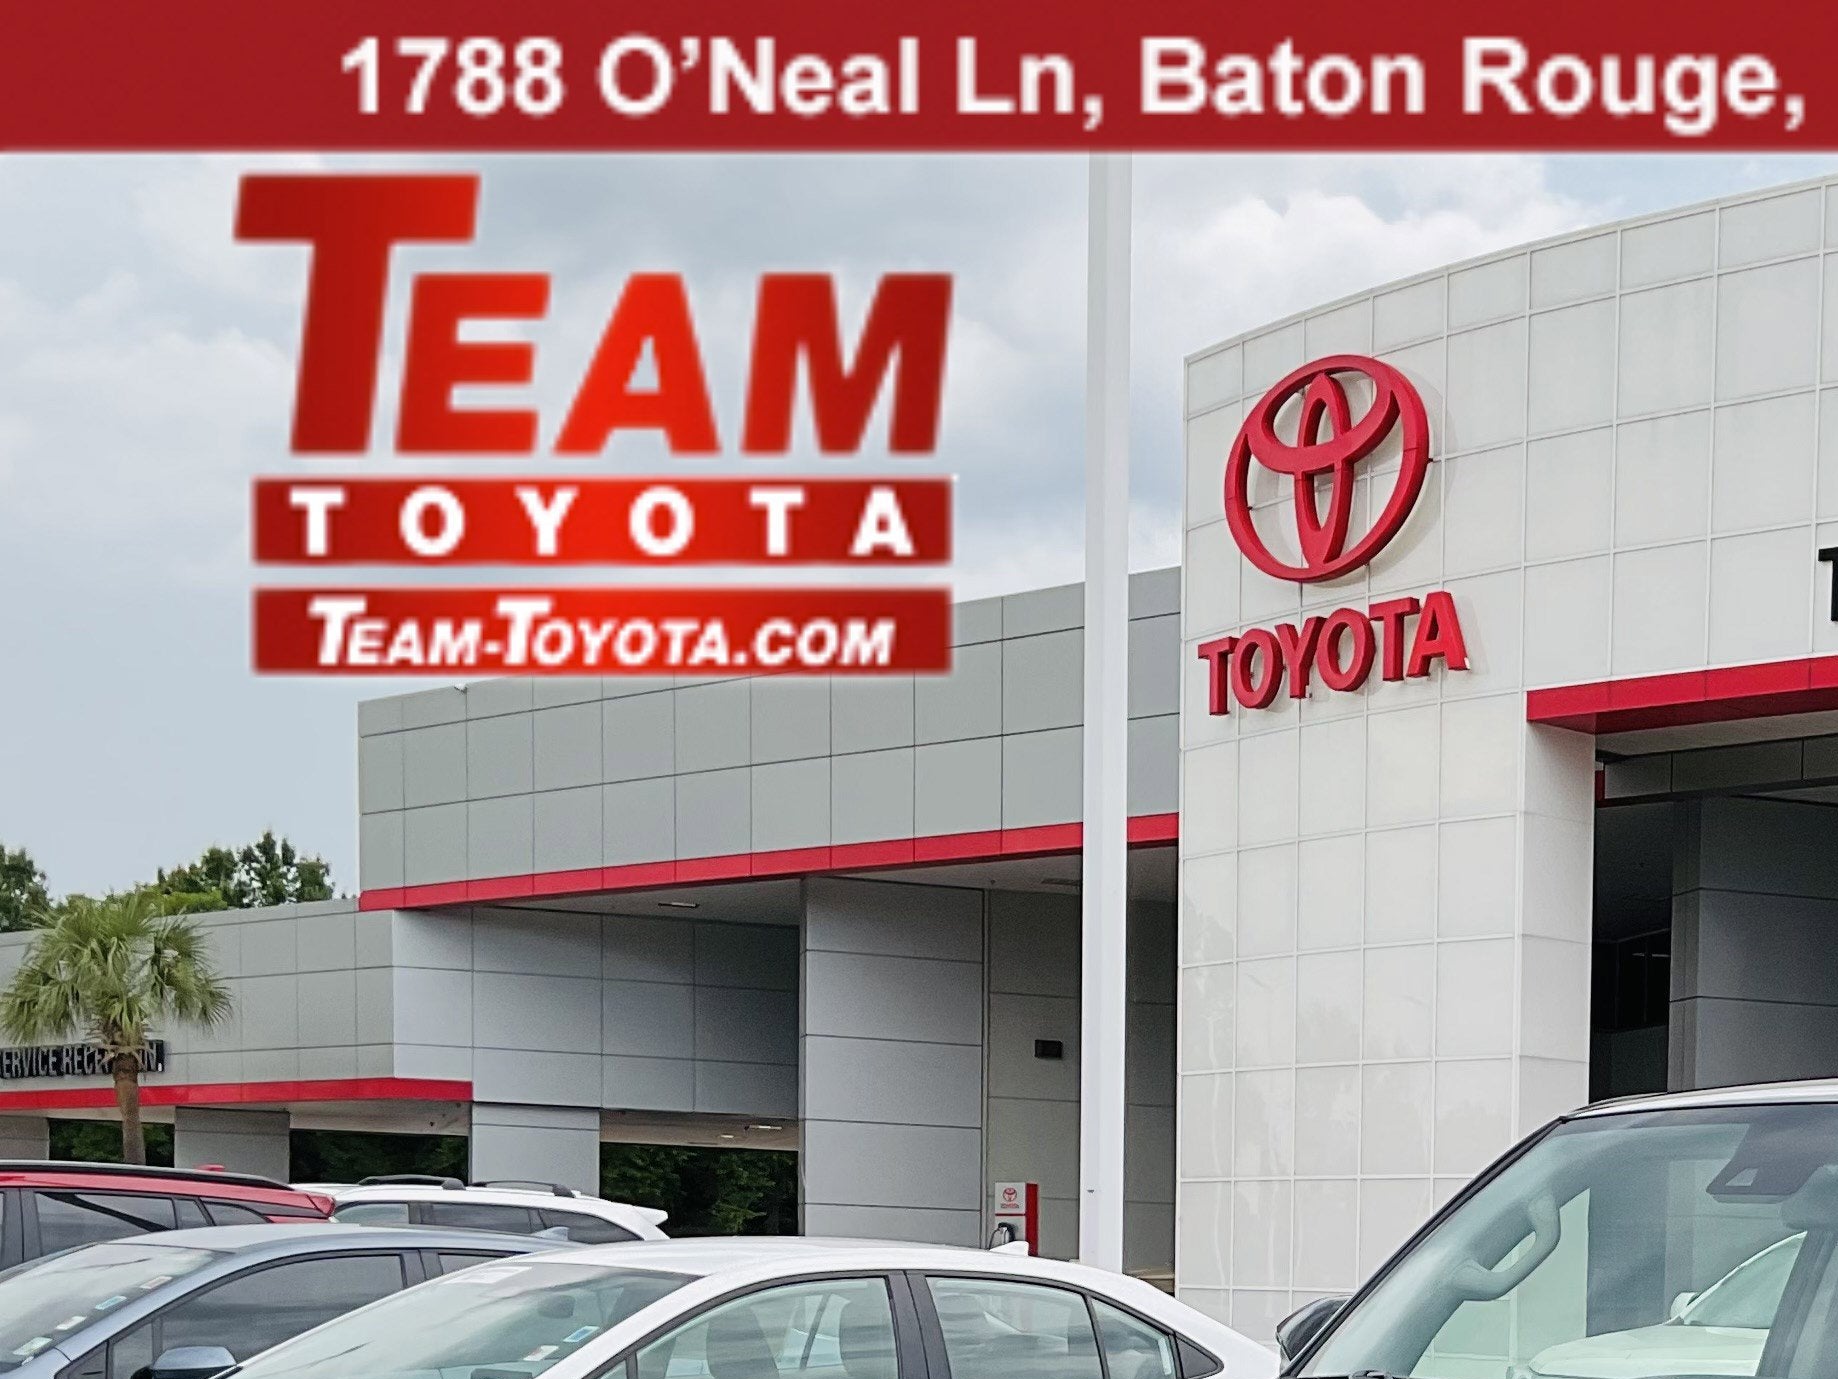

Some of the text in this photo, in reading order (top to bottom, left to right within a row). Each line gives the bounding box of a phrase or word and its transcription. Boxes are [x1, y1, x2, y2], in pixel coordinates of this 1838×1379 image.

[1198, 590, 1469, 716] TOYOTA
[0, 1040, 157, 1079] ERVICE RECEN
